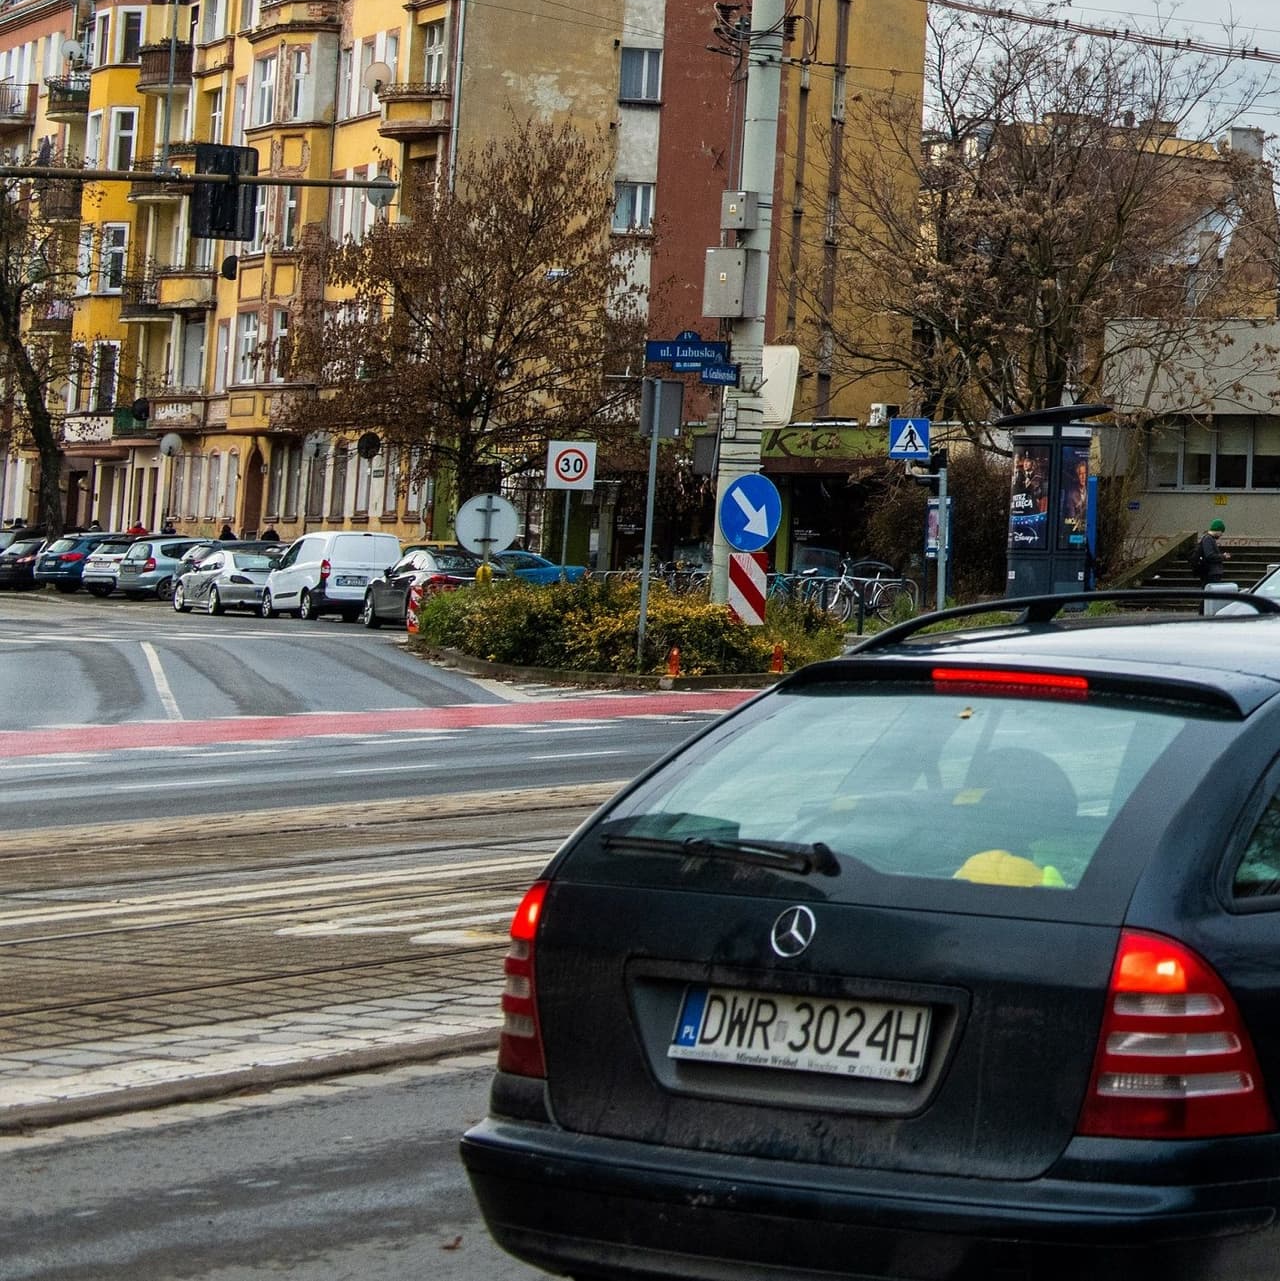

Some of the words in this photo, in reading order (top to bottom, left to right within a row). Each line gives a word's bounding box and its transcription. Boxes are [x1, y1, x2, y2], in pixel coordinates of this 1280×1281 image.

[660, 346, 672, 357] ul.
[676, 346, 715, 358] Lubuska
[560, 457, 584, 473] 30
[682, 1025, 695, 1040] PL
[699, 994, 778, 1050] DWR
[787, 1002, 923, 1065] 3024H
